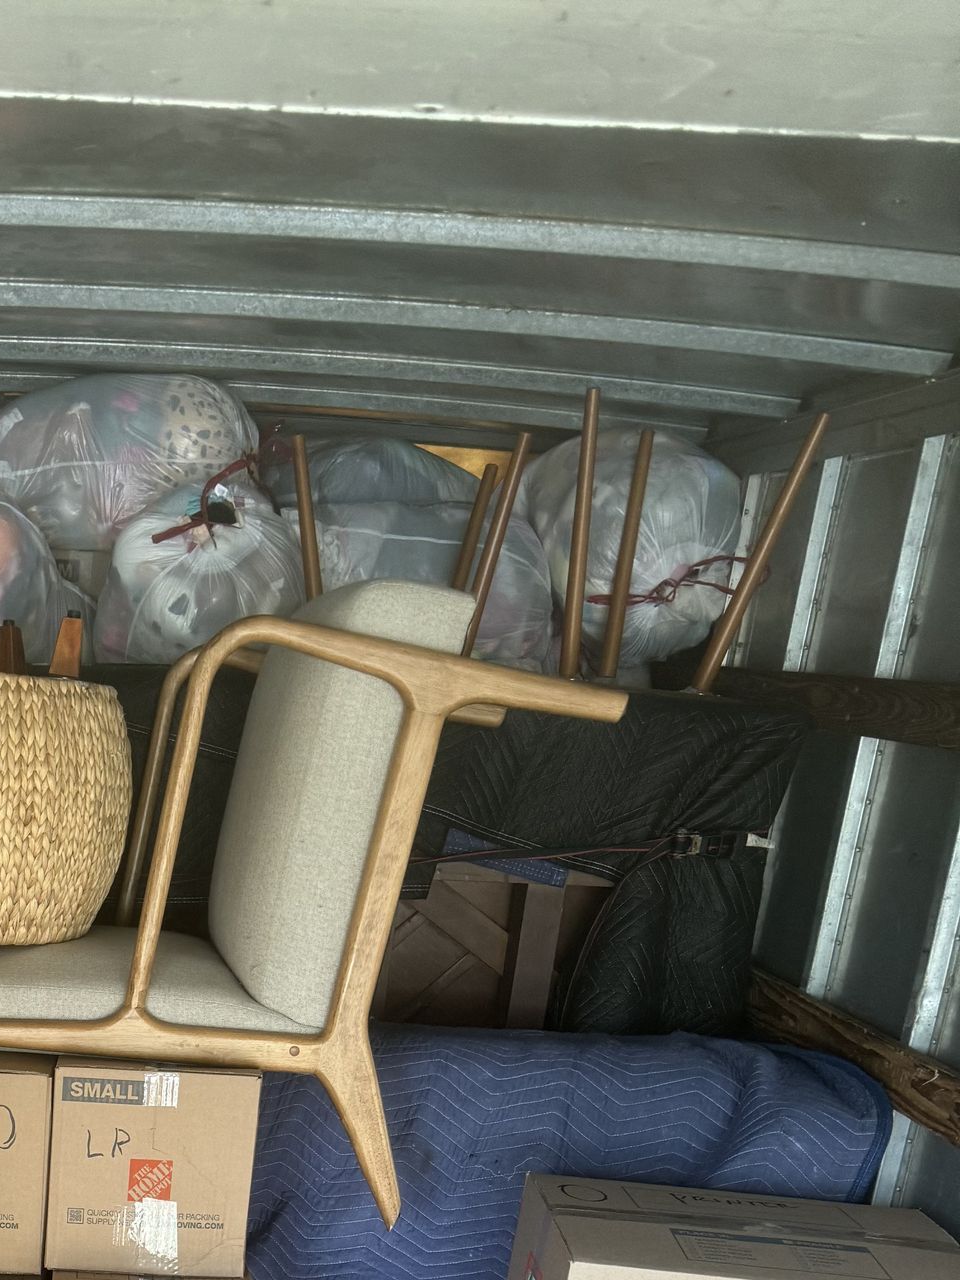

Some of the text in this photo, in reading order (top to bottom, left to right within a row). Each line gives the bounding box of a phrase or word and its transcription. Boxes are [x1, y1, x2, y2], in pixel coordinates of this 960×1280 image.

[70, 1081, 138, 1100] SMALL
[128, 1159, 173, 1201] HOME
[132, 1163, 152, 1181] THE
